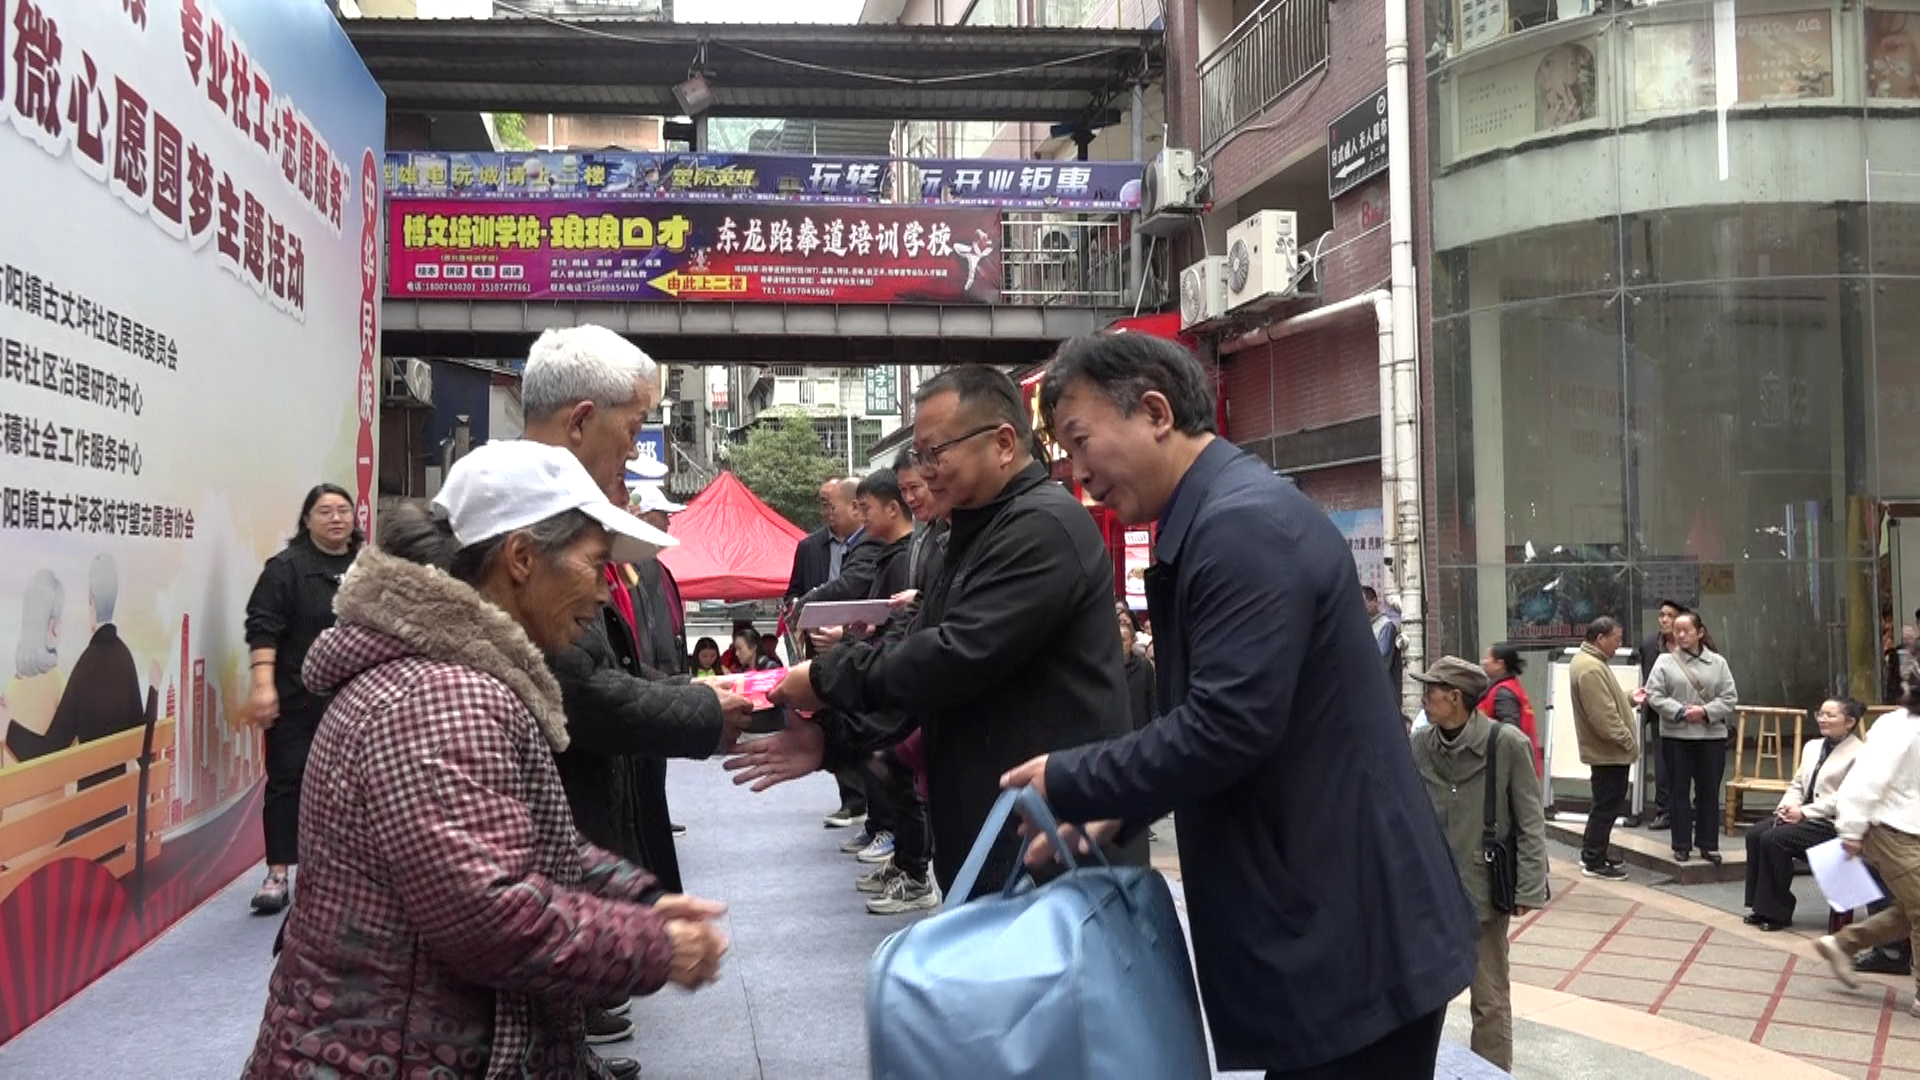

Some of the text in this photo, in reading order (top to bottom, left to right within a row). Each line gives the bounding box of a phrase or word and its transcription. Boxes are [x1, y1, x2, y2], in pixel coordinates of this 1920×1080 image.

[0, 0, 304, 312] 微心愿圆梦主题活动
[809, 163, 880, 193] 玩转
[954, 166, 1092, 196] 开业钜惠
[716, 216, 953, 258] 东龙跆拳道培训学校
[667, 275, 743, 291] 由此上二楼
[0, 337, 143, 416] 民社区治理研究中心
[0, 412, 142, 476] 穗社会工作服务中心
[0, 487, 195, 539] 阳镇古文坪茶城守望志愿者协会
